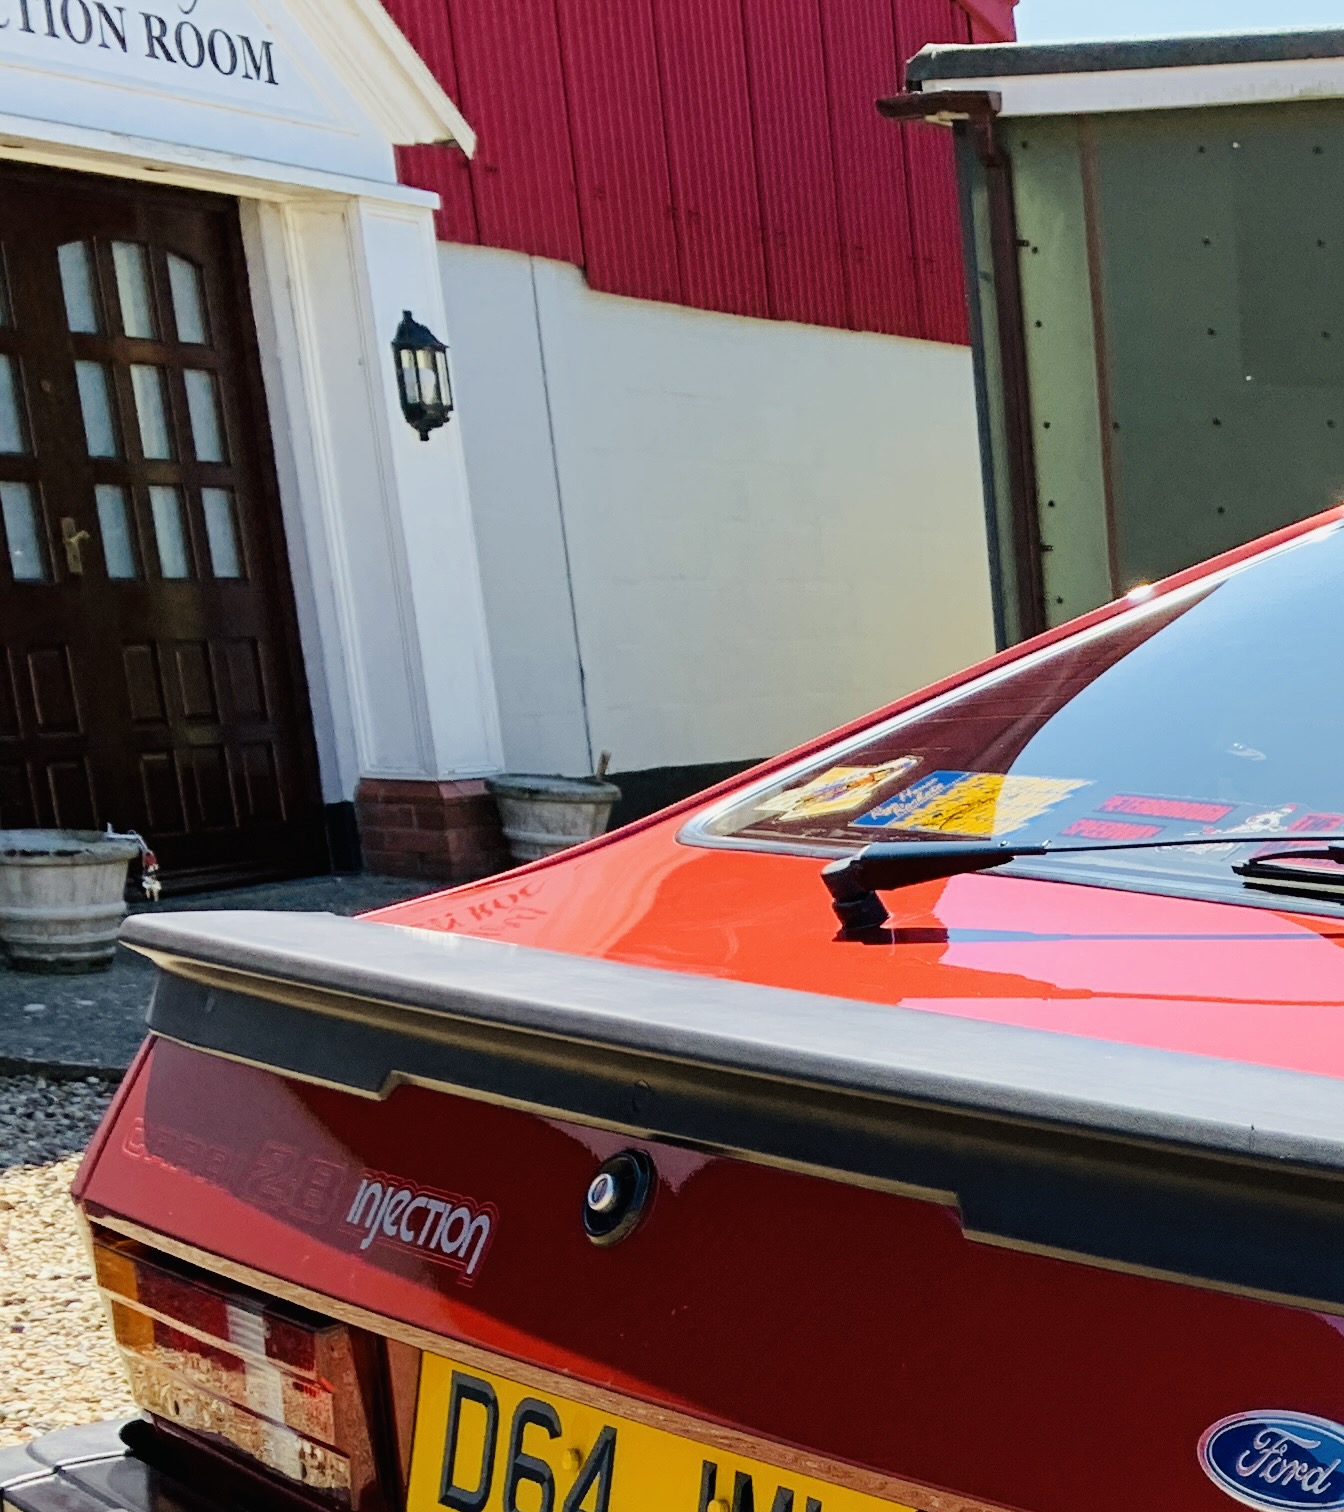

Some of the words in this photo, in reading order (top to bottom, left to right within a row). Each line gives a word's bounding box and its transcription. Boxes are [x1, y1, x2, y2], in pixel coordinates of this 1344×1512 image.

[0, 0, 127, 52] TION
[139, 11, 279, 85] ROOM
[1235, 1427, 1342, 1495] Ford
